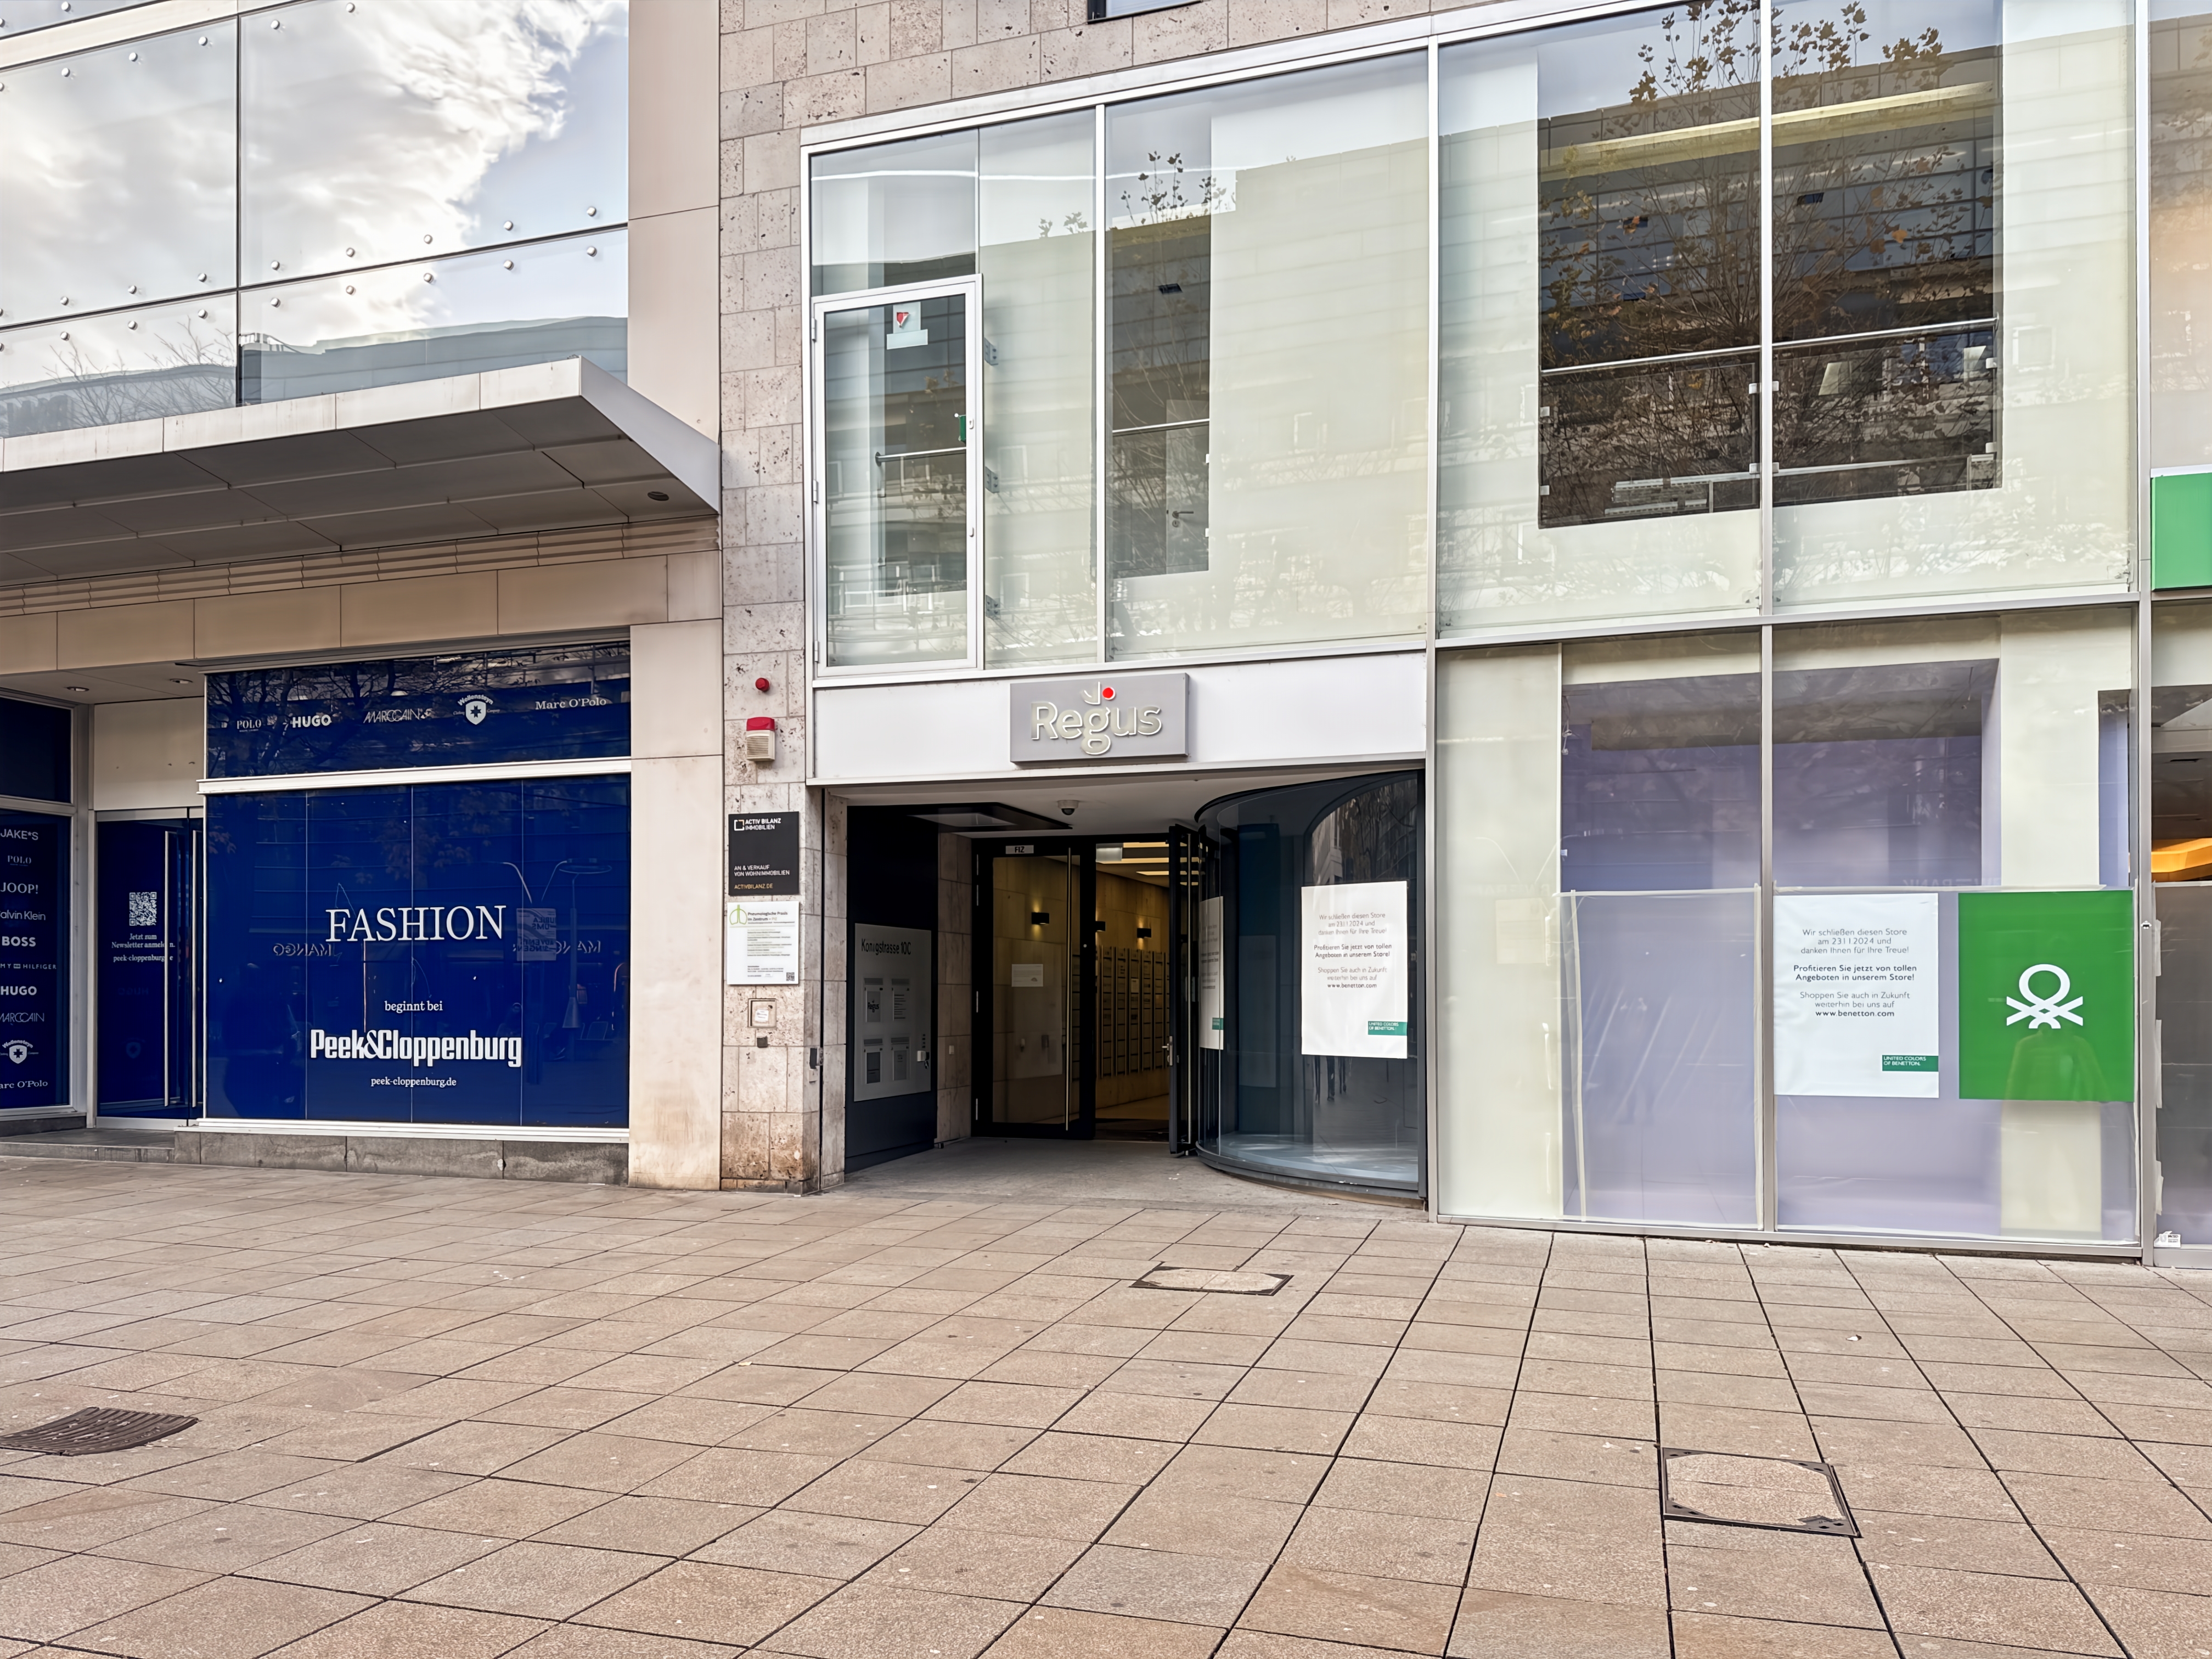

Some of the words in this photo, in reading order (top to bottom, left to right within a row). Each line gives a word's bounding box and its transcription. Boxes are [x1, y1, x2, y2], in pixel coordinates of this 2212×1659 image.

[457, 694, 494, 706] Wellensteyn
[536, 700, 566, 710] Marc
[569, 697, 607, 708] O'Polo
[237, 719, 262, 729] POLO
[292, 715, 331, 728] HUGO
[1031, 701, 1162, 756] Regus
[7, 855, 32, 864] POLO
[0, 882, 39, 895] JOOP!
[0, 909, 22, 920] alvin
[24, 910, 46, 921] Klein
[325, 905, 506, 942] FASHION
[2, 936, 36, 947] BOSS
[900, 941, 911, 955] 10C
[1853, 964, 1873, 973] jetzt
[1796, 974, 1839, 982] Angeboten
[0, 986, 37, 996] HUGO
[1800, 991, 1834, 1000] Shoppen
[385, 1000, 425, 1014] beginnt
[427, 1000, 443, 1012] bei
[310, 1029, 522, 1068] Peek&Cloppenburg
[17, 1079, 48, 1088] O'Polo
[370, 1076, 457, 1088] peek-cloppenburg.de
